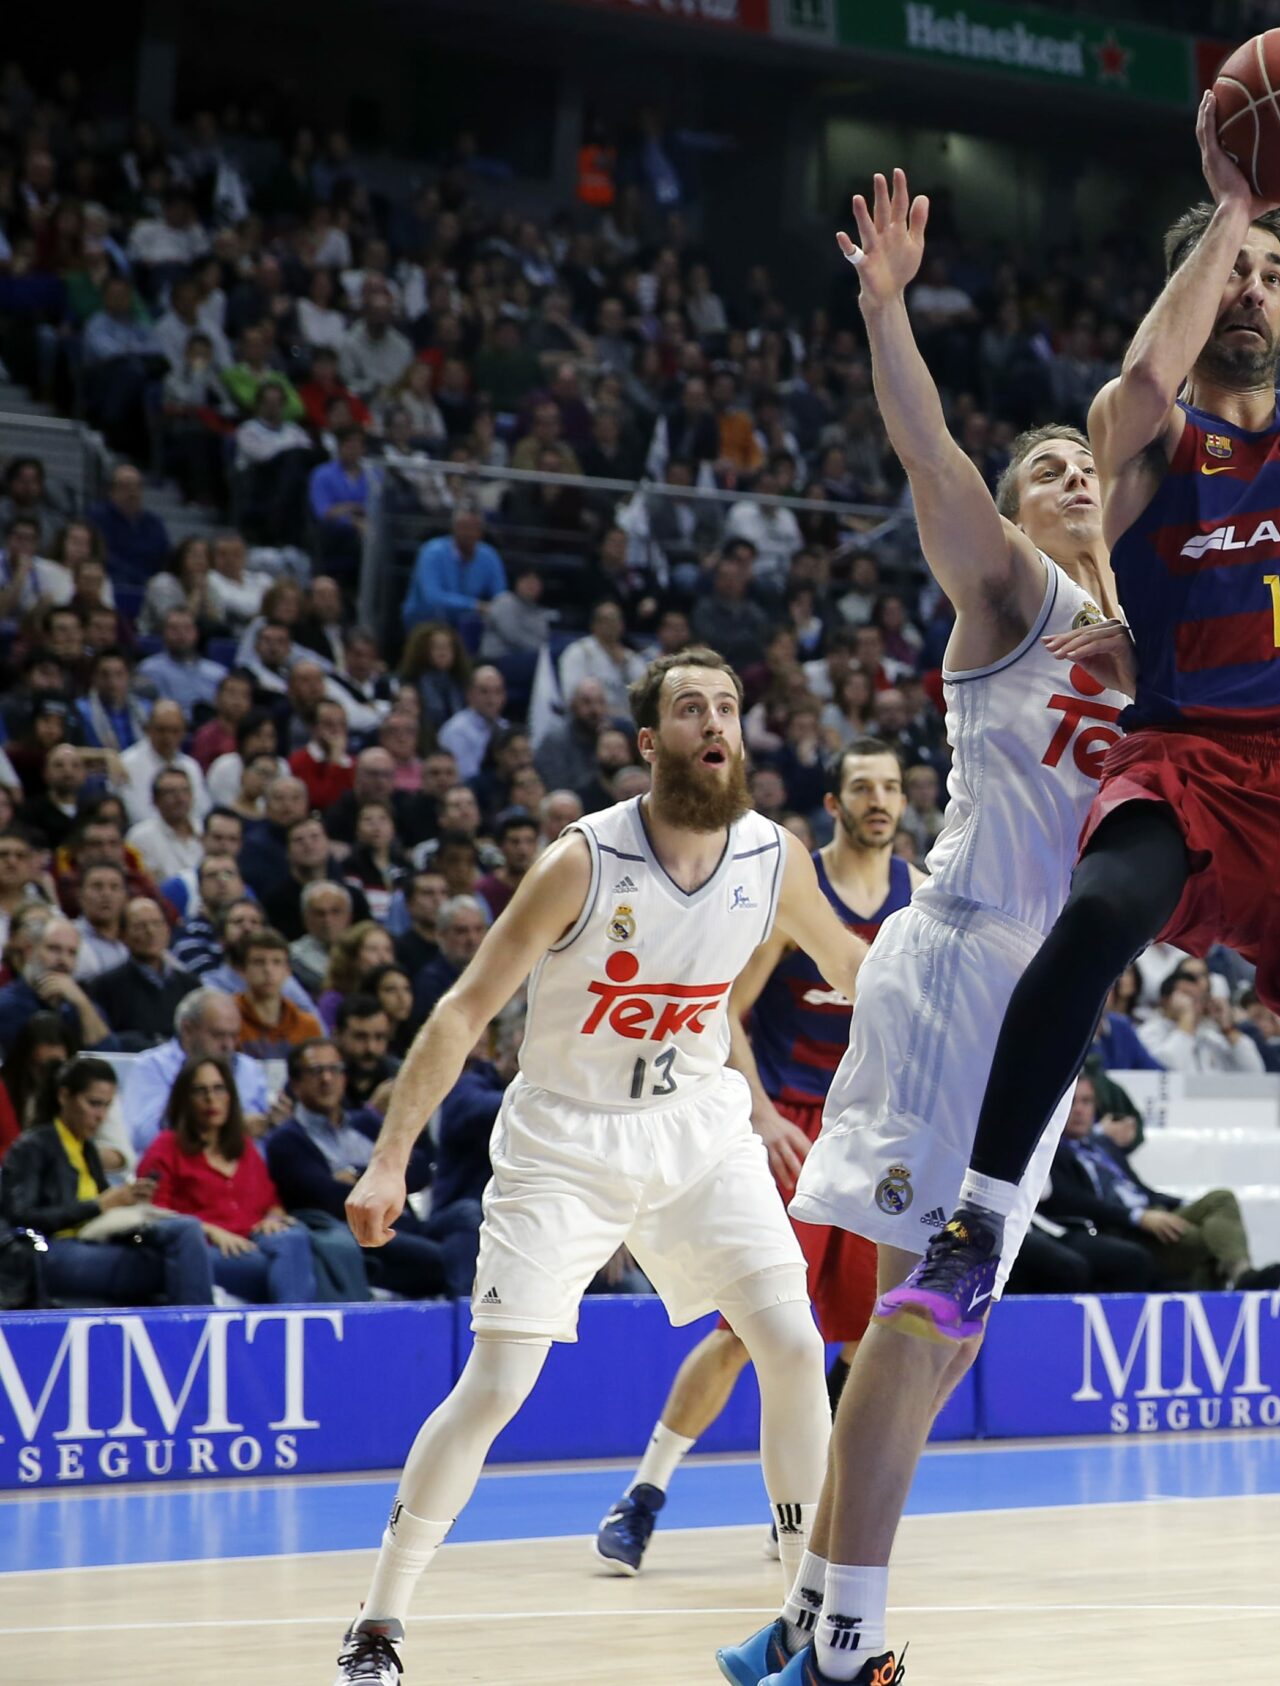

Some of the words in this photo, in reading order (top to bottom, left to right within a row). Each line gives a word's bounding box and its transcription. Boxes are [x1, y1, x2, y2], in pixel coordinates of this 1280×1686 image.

[903, 2, 1085, 77] Heineken
[1041, 692, 1124, 781] Te
[630, 1046, 678, 1100] 13
[0, 1310, 344, 1442] MMT
[18, 1434, 299, 1483] SEGUROS
